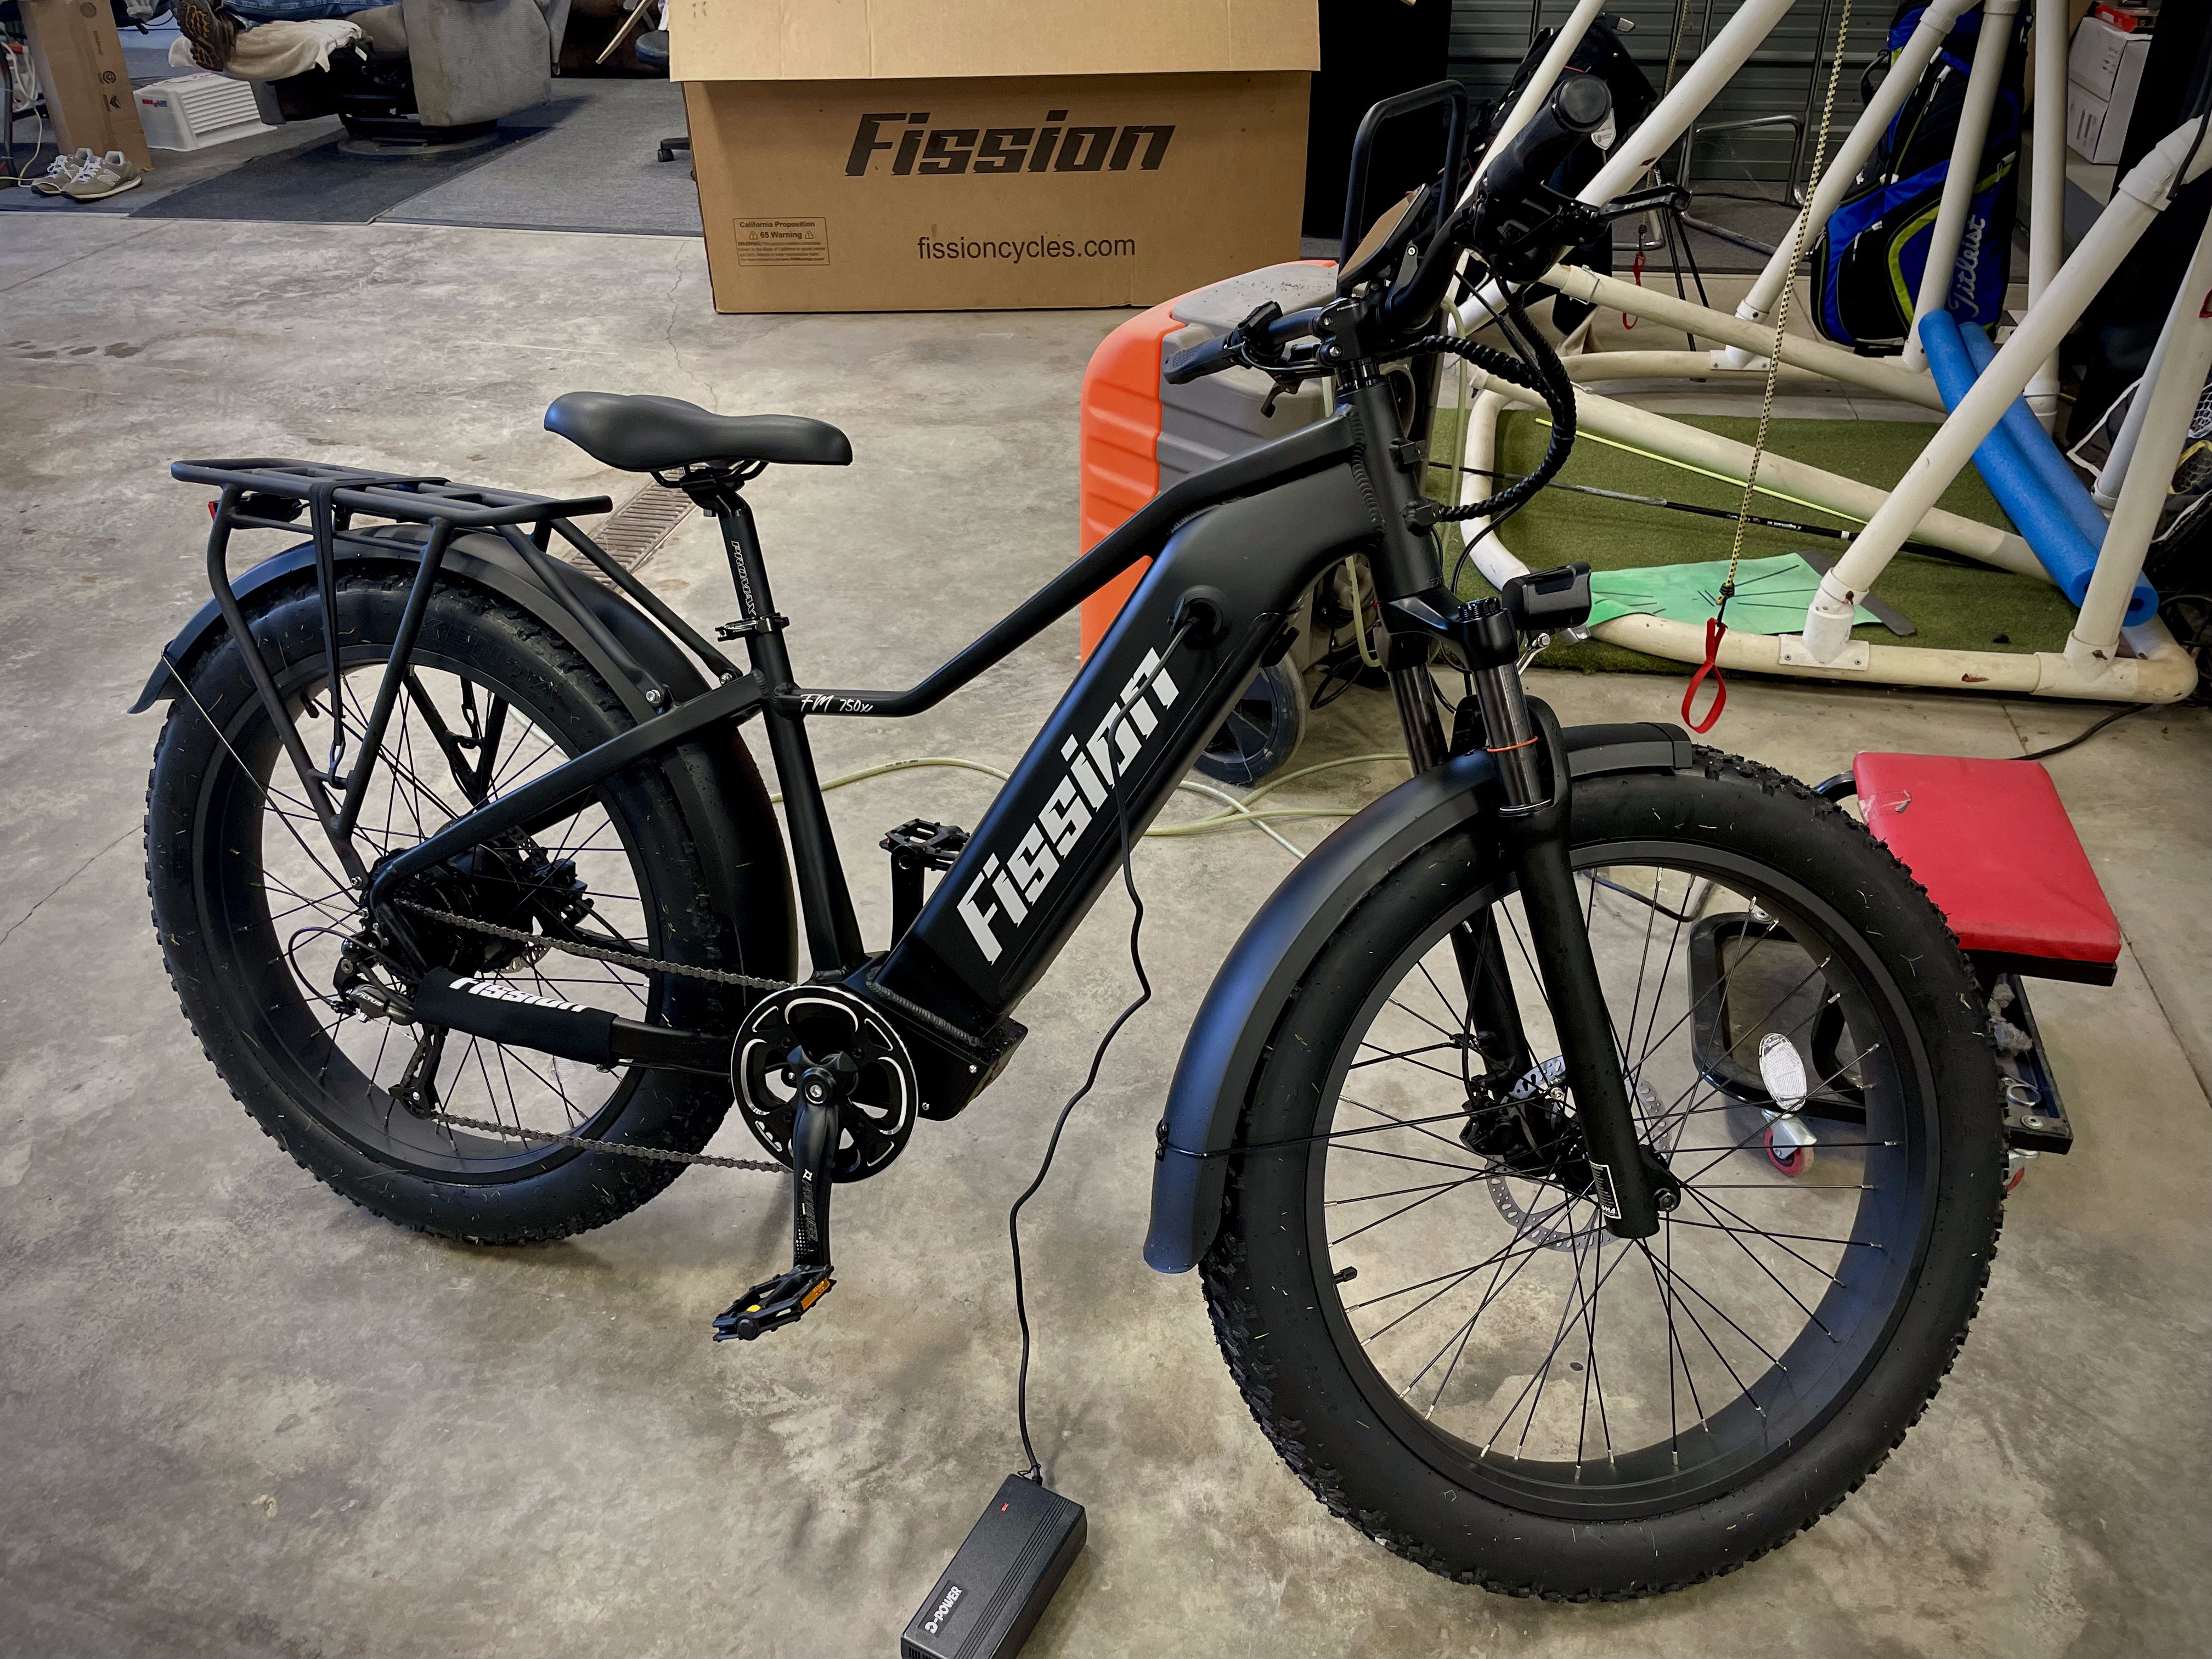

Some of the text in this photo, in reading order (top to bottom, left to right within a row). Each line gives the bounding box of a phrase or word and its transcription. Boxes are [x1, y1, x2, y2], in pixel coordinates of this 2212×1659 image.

[844, 110, 1175, 177] Fission
[770, 231, 802, 239] Warning
[917, 235, 1135, 264] fissioncycles.com
[1949, 214, 1986, 318] Titleist
[731, 540, 757, 616] PROMAX
[800, 693, 834, 713] FM
[957, 647, 1179, 966] Fission
